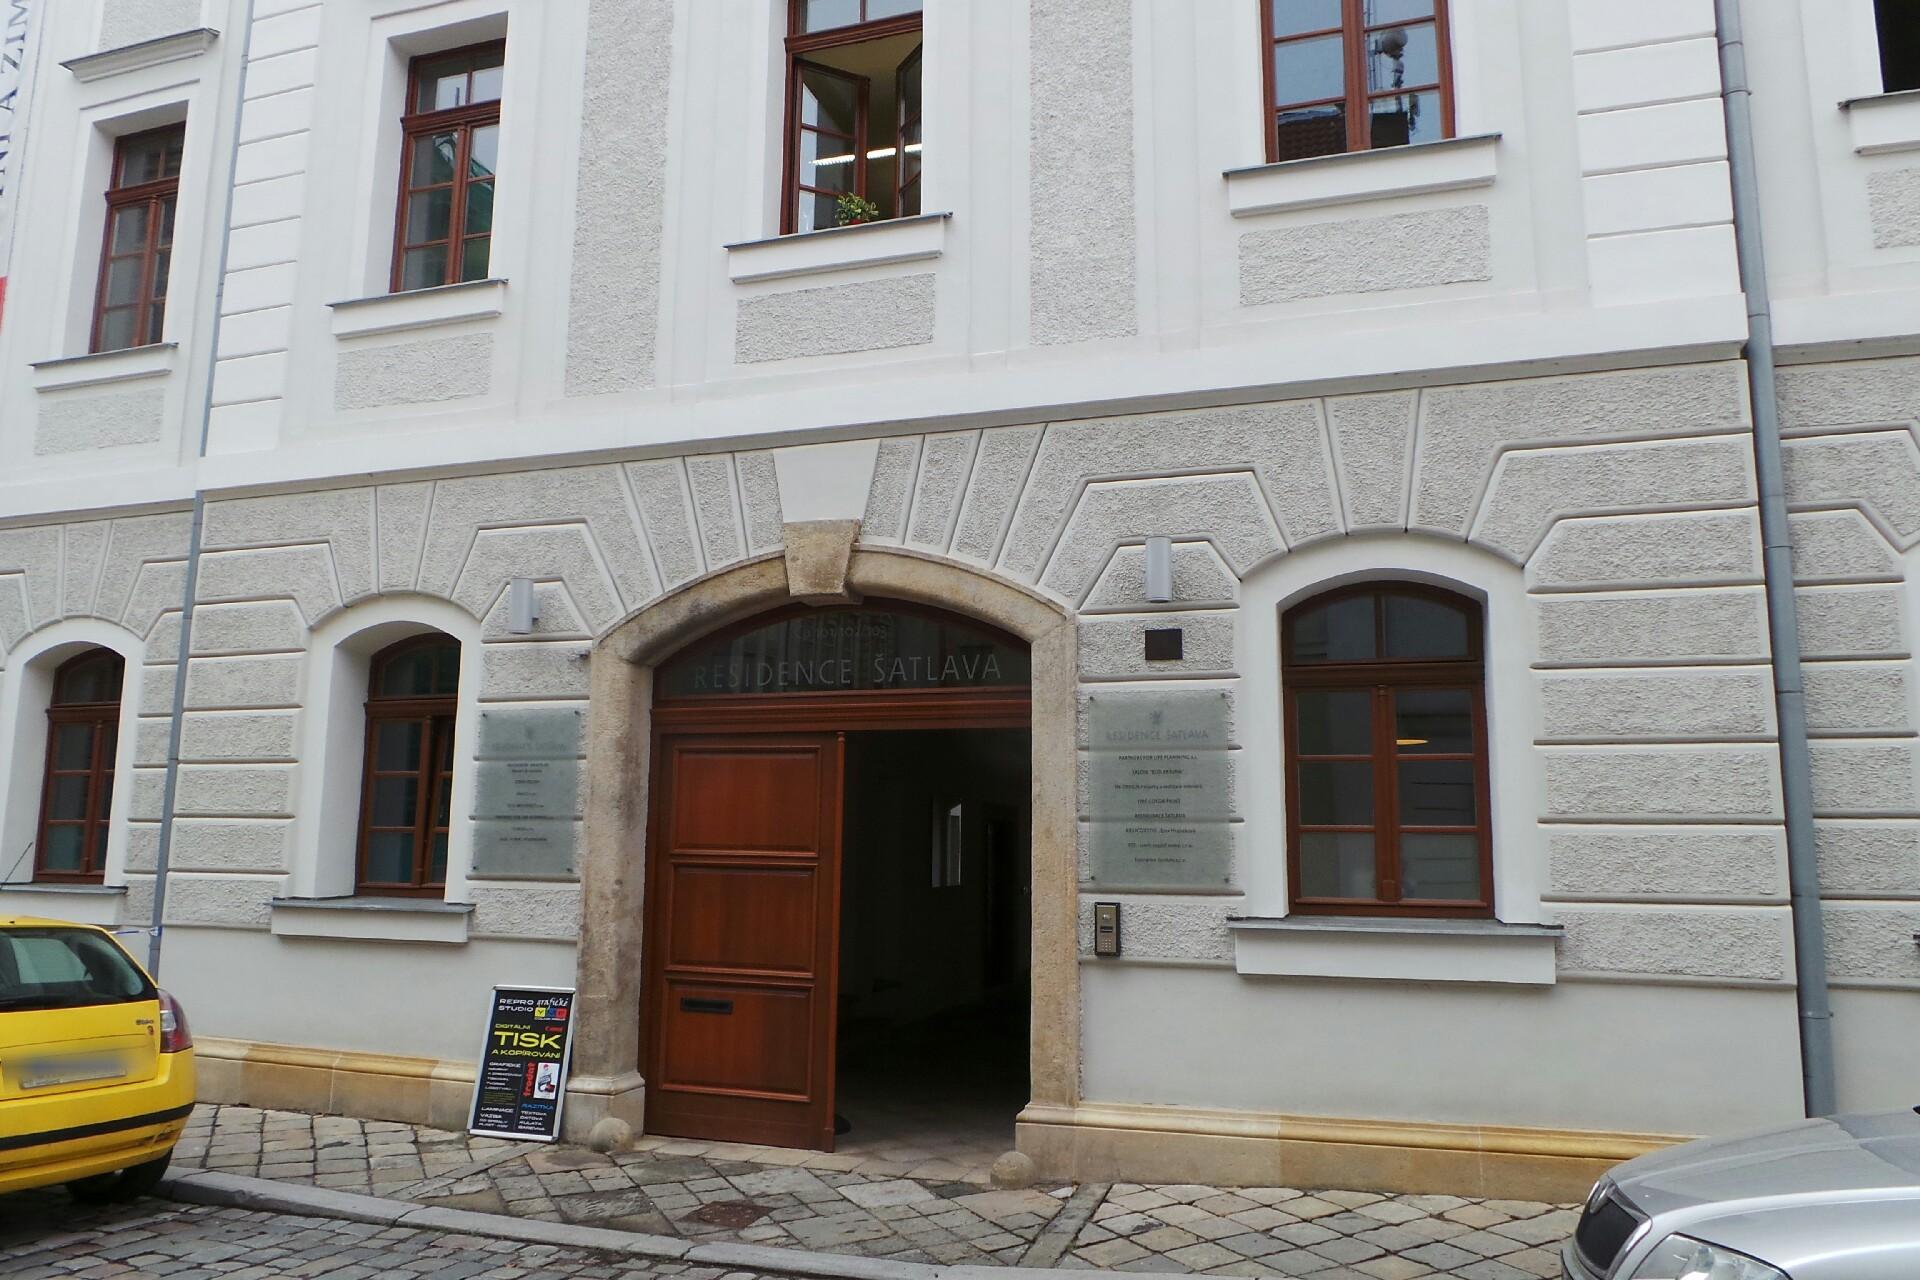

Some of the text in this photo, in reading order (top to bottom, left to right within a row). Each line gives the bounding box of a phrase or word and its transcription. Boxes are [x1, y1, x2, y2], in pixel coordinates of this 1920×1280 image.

[695, 654, 1001, 689] RESIDENCE ŠATLAVA
[494, 1031, 562, 1049] TISK
